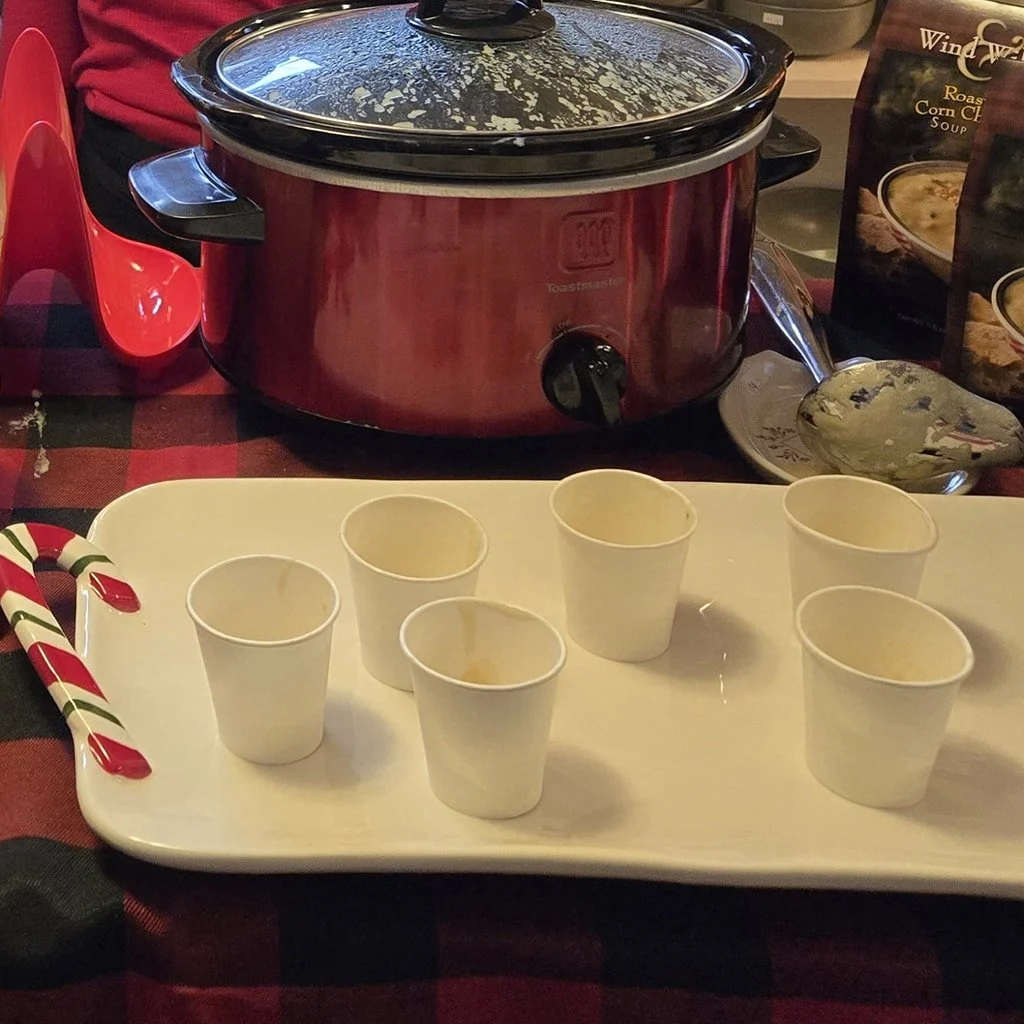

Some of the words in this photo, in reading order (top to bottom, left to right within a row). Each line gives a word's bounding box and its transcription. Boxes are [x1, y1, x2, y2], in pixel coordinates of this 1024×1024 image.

[920, 28, 979, 59] Wind
[943, 85, 986, 105] Roas
[915, 100, 956, 118] Corn
